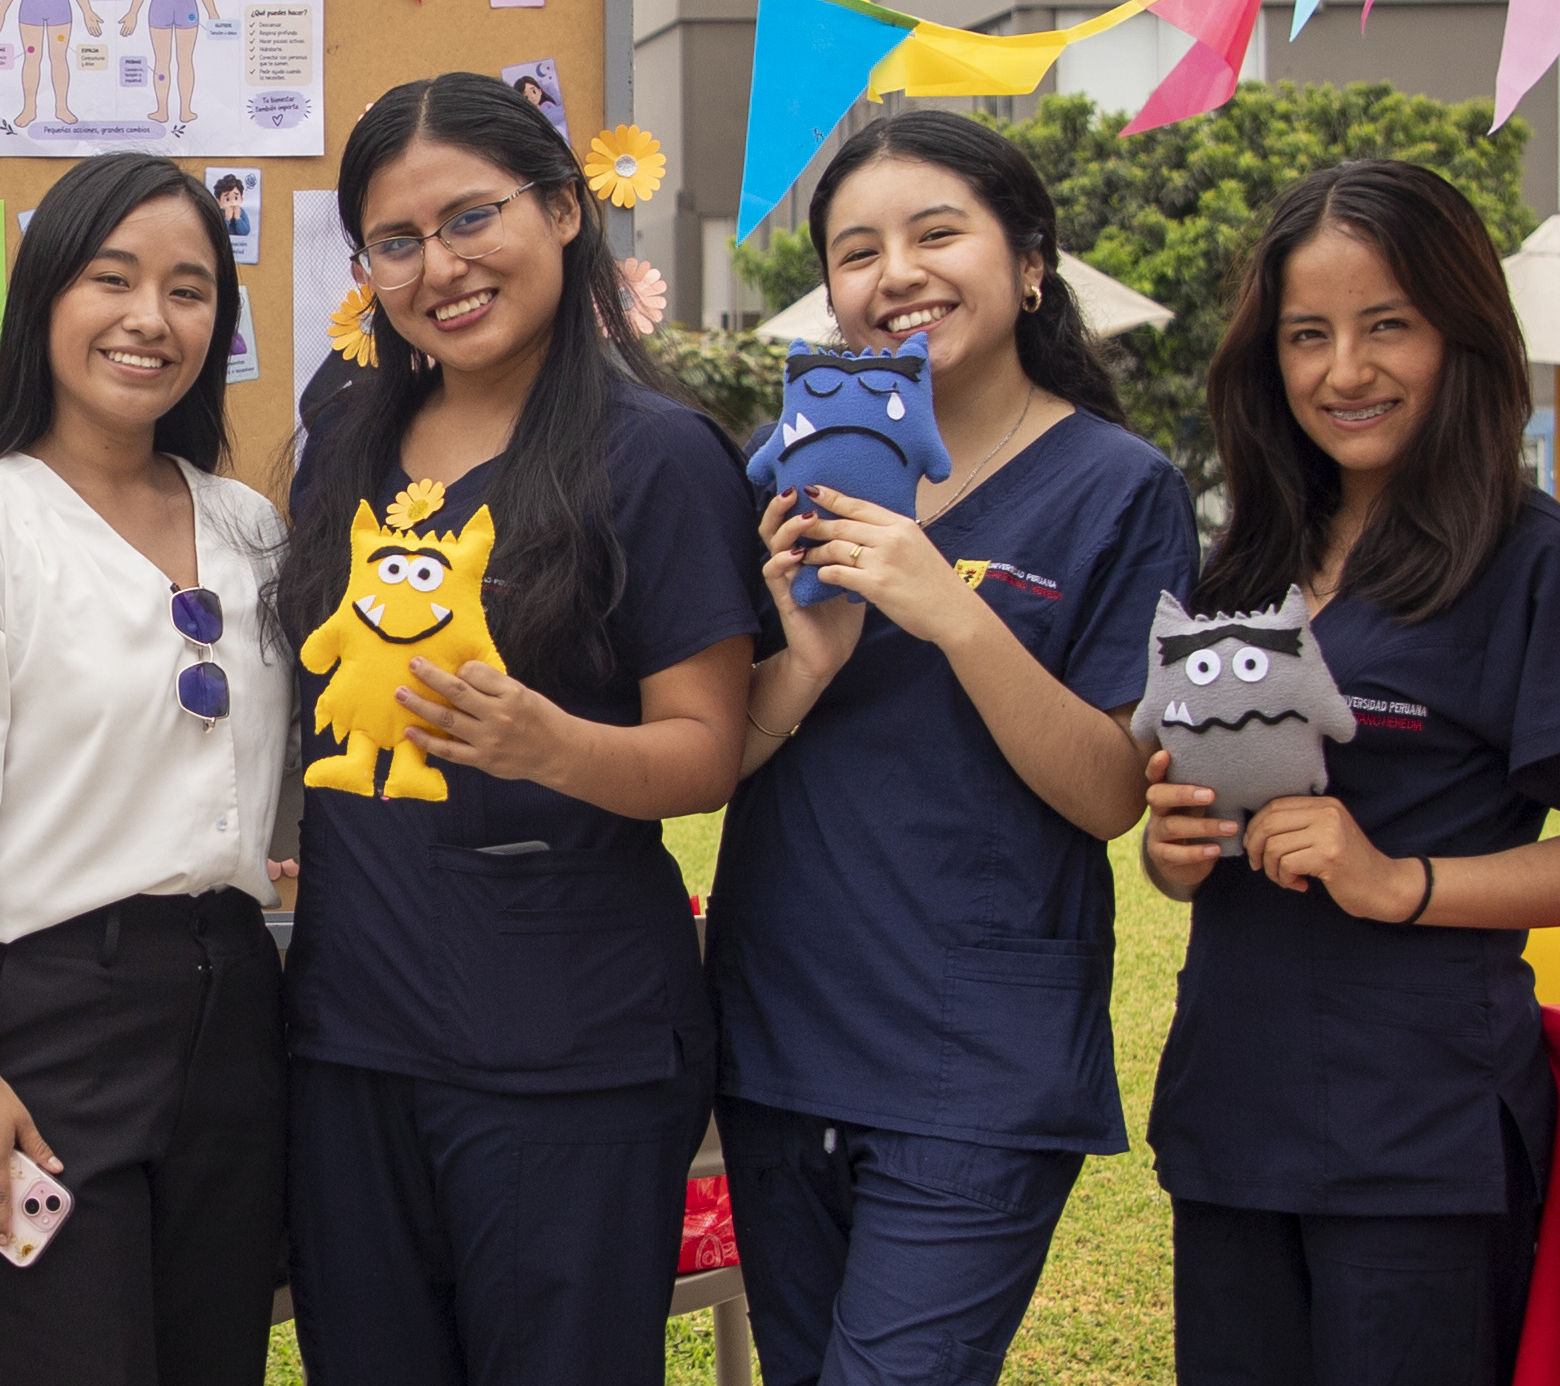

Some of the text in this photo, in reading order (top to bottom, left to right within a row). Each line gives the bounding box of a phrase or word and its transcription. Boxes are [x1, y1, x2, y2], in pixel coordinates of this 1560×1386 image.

[250, 9, 308, 19] ¿Qué puedes hacer?
[270, 95, 294, 103] bienestar
[44, 125, 71, 137] Pequeñas
[100, 125, 124, 137] grandes
[125, 125, 150, 135] cambios
[1388, 701, 1427, 717] PERUANA
